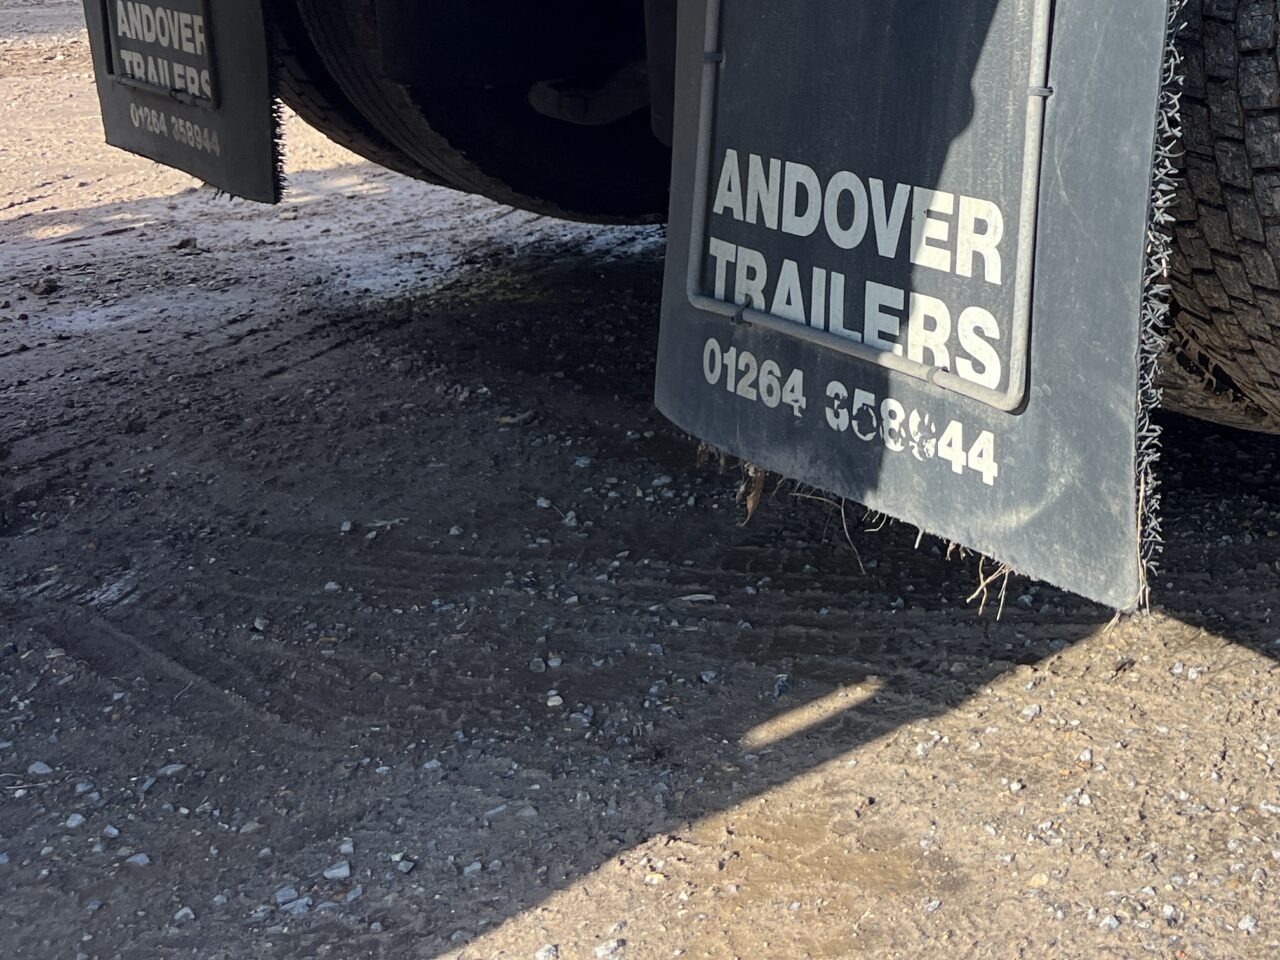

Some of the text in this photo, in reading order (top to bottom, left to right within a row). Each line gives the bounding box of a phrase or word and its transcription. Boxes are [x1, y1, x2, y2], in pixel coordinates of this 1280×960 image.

[130, 103, 168, 136] 01264
[712, 148, 1004, 285] ANDOVER
[709, 237, 1001, 390] TRAILERS
[703, 337, 806, 418] 01264
